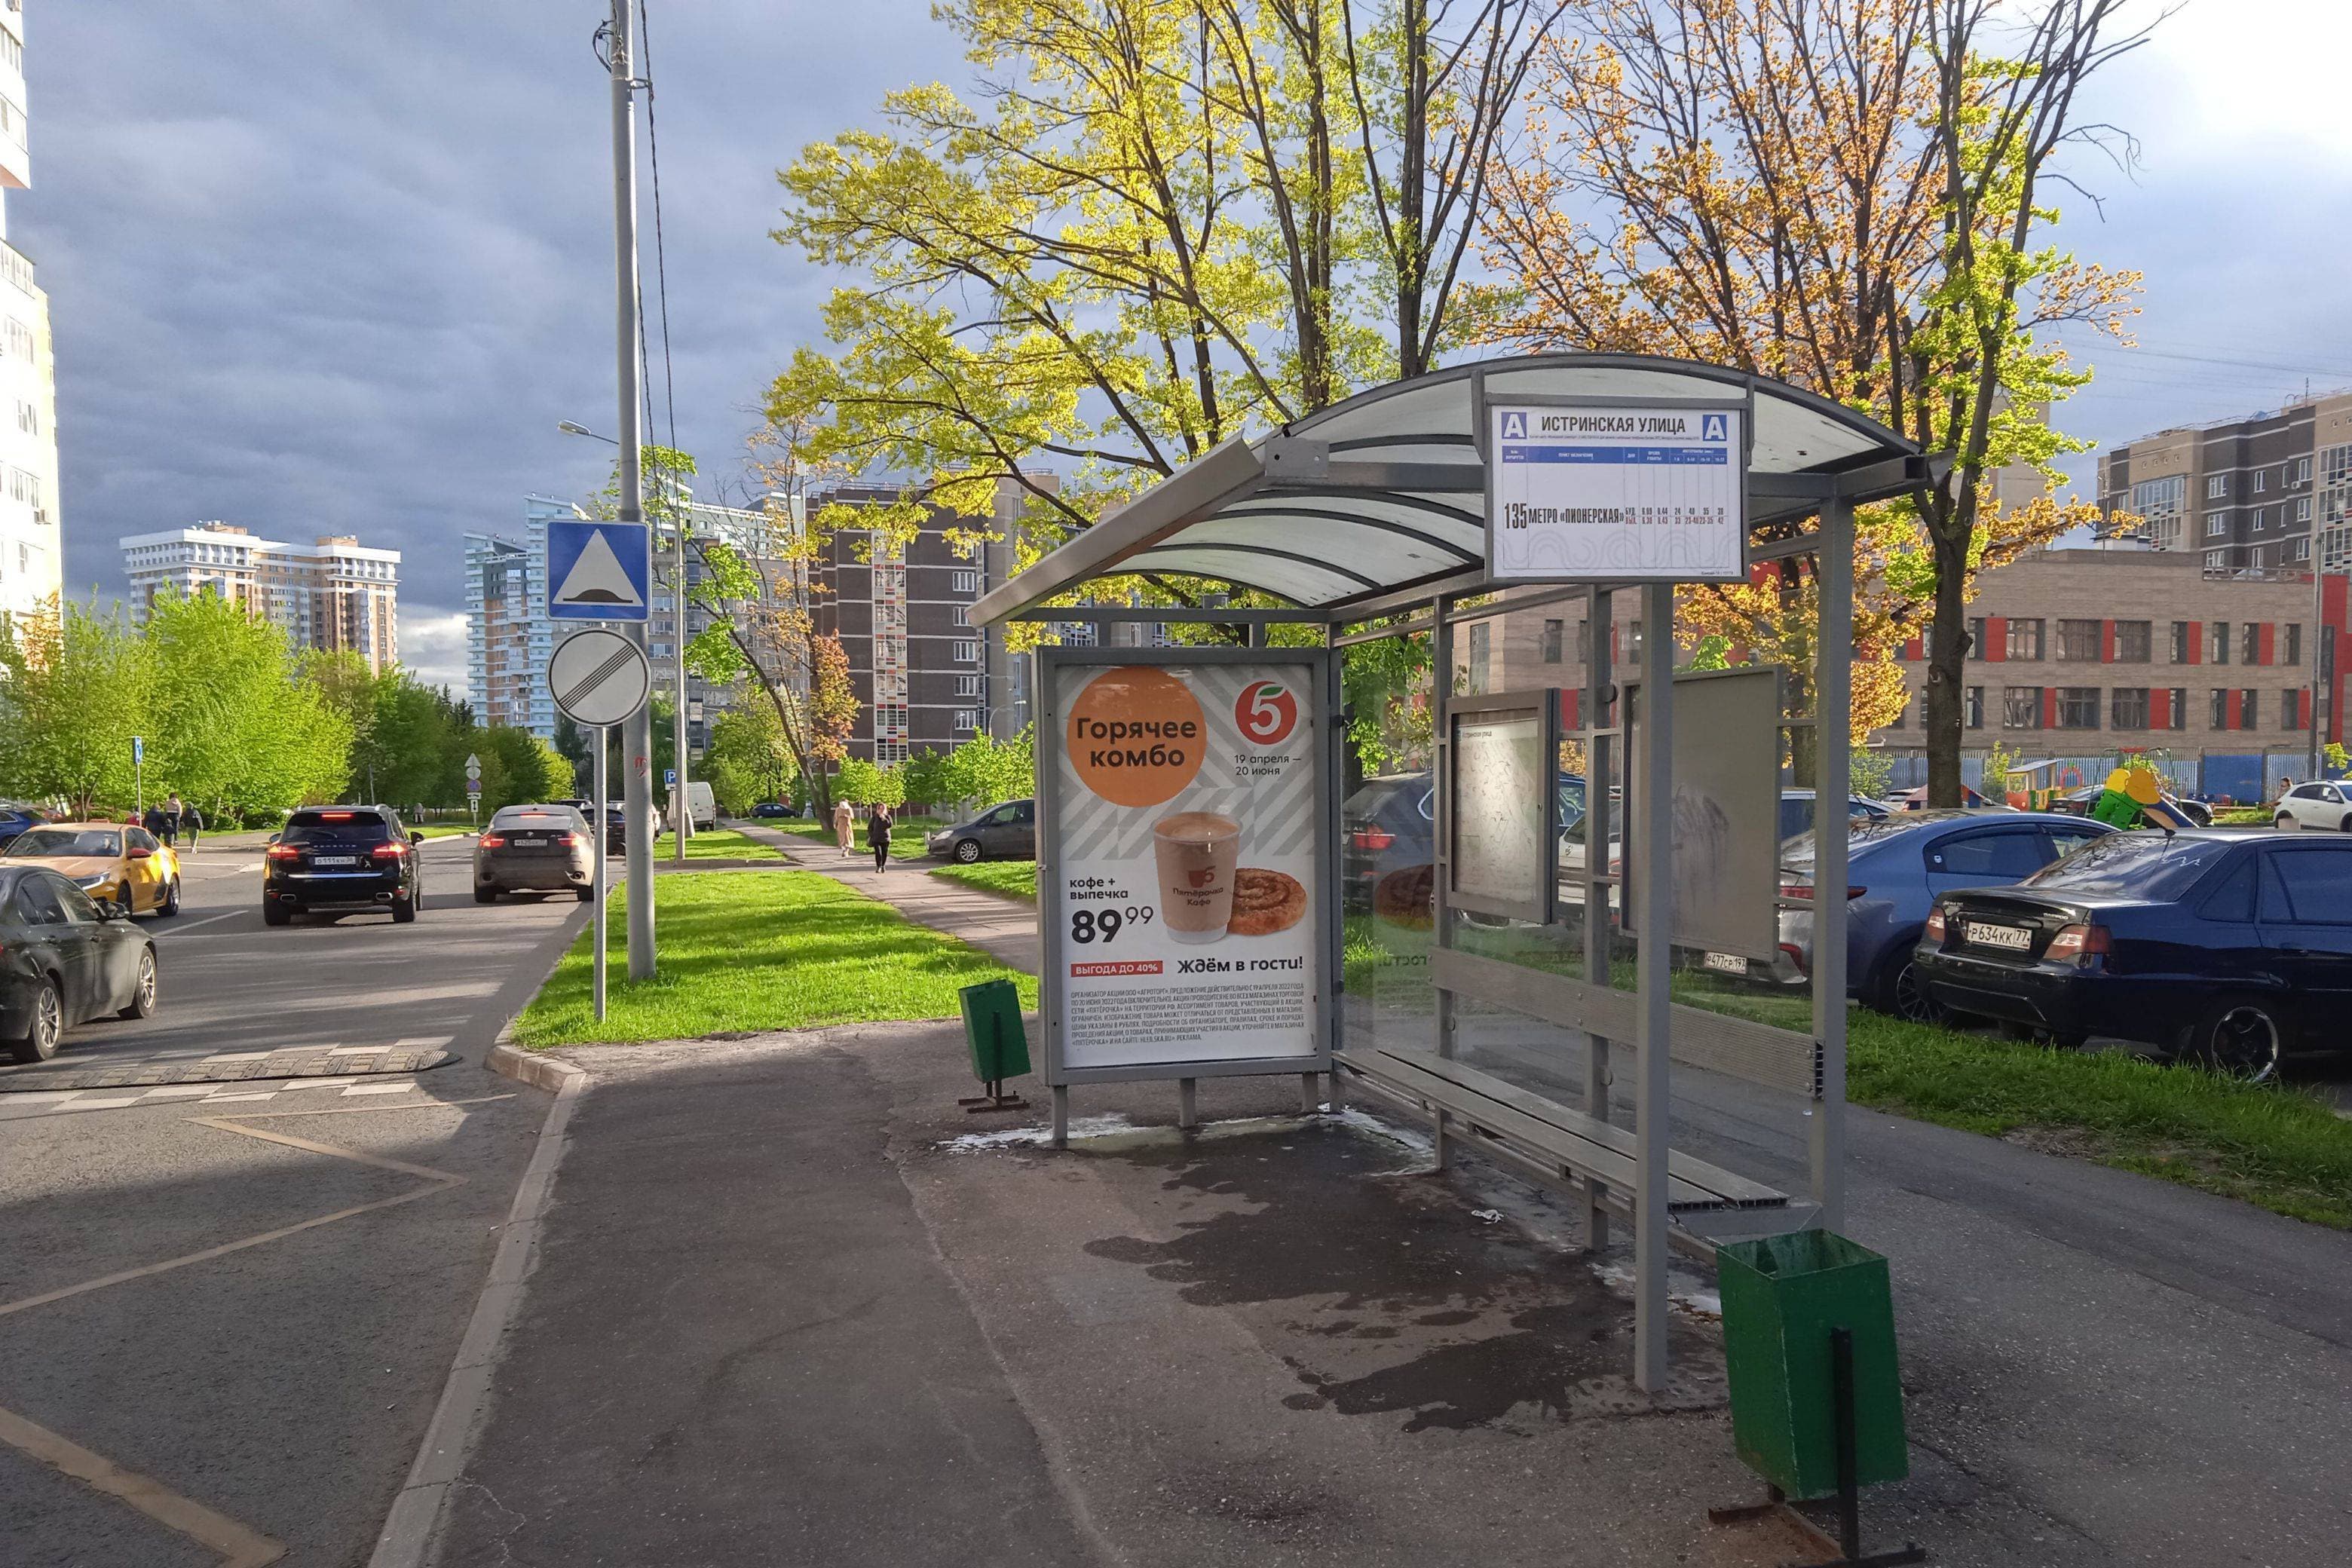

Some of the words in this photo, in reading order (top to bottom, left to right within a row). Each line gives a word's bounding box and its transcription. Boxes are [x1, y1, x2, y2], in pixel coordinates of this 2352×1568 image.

[1542, 416, 1634, 432] ИСТРИНСКАЯ
[1640, 418, 1686, 435] УЛИЦА
[1505, 503, 1527, 528] 135
[1529, 508, 1557, 523] МЕТРО
[1560, 508, 1624, 524] «ПИОНЕРСКАЯ»
[1250, 684, 1286, 735] 5
[1077, 718, 1197, 744] Горячее
[1090, 743, 1184, 767] комбо
[1234, 755, 1246, 764] 19
[1250, 756, 1289, 765] апреля
[1236, 767, 1248, 776] 20
[1070, 877, 1104, 890] кофе
[1070, 890, 1129, 899] выпечка
[1072, 909, 1122, 944] 89
[1125, 906, 1154, 924] 99
[1076, 966, 1117, 975] ВЫГОДА
[1119, 965, 1134, 973] ДО
[1137, 963, 1158, 972] 40%
[1178, 957, 1230, 973] Ждём
[1236, 960, 1245, 971] в
[1251, 956, 1303, 970] гости!
[1071, 990, 1107, 998] ОРГАНИЗАТОР
[1170, 986, 1207, 994] ПРЕДЛОЖЕНИЕ
[1207, 984, 1249, 993] ДЕЙСТВИТЕЛЬНО
[1177, 1001, 1214, 1010] АССОРТИМЕНТ
[1104, 1012, 1142, 1021] ИЗОБРАЖЕНИЕ
[1141, 1019, 1180, 1027] ПОДРОБНОСТИ
